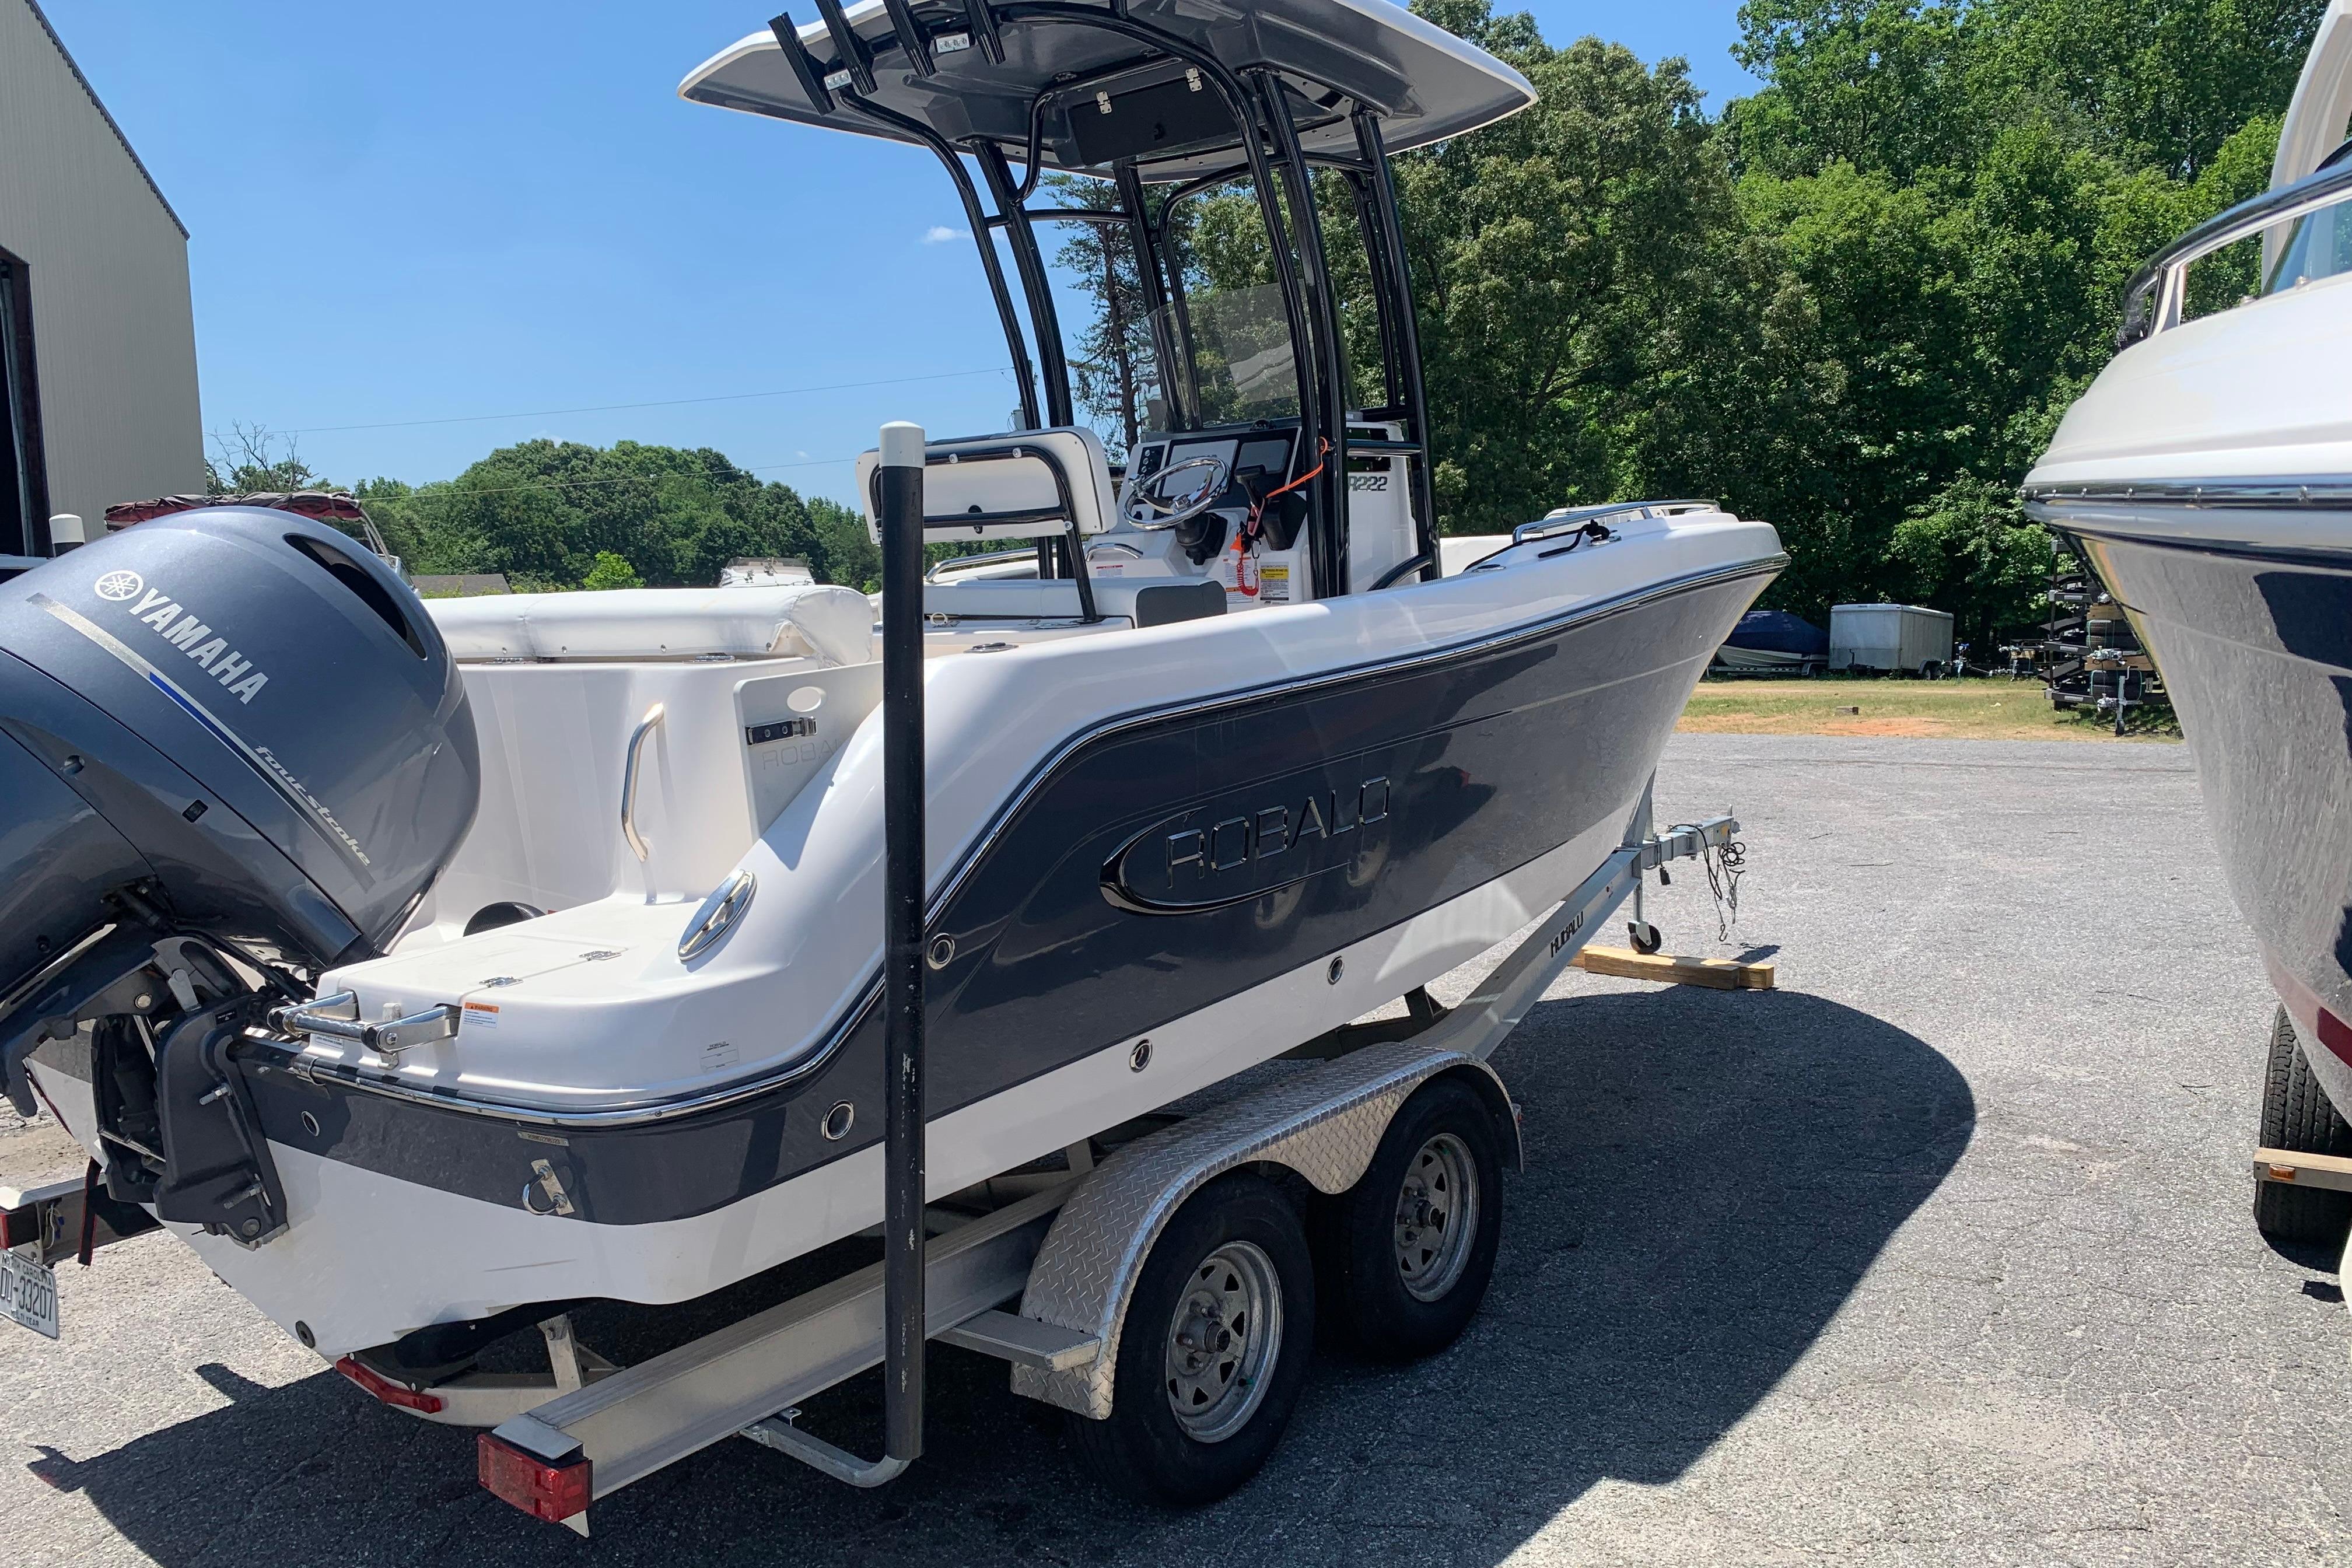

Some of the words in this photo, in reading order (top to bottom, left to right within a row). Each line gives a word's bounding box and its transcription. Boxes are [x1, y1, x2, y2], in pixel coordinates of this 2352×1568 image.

[1348, 475, 1388, 491] R222
[128, 587, 269, 705] YAMAHA
[1167, 776, 1390, 888] ROBALO
[26, 1317, 39, 1329] YEAR
